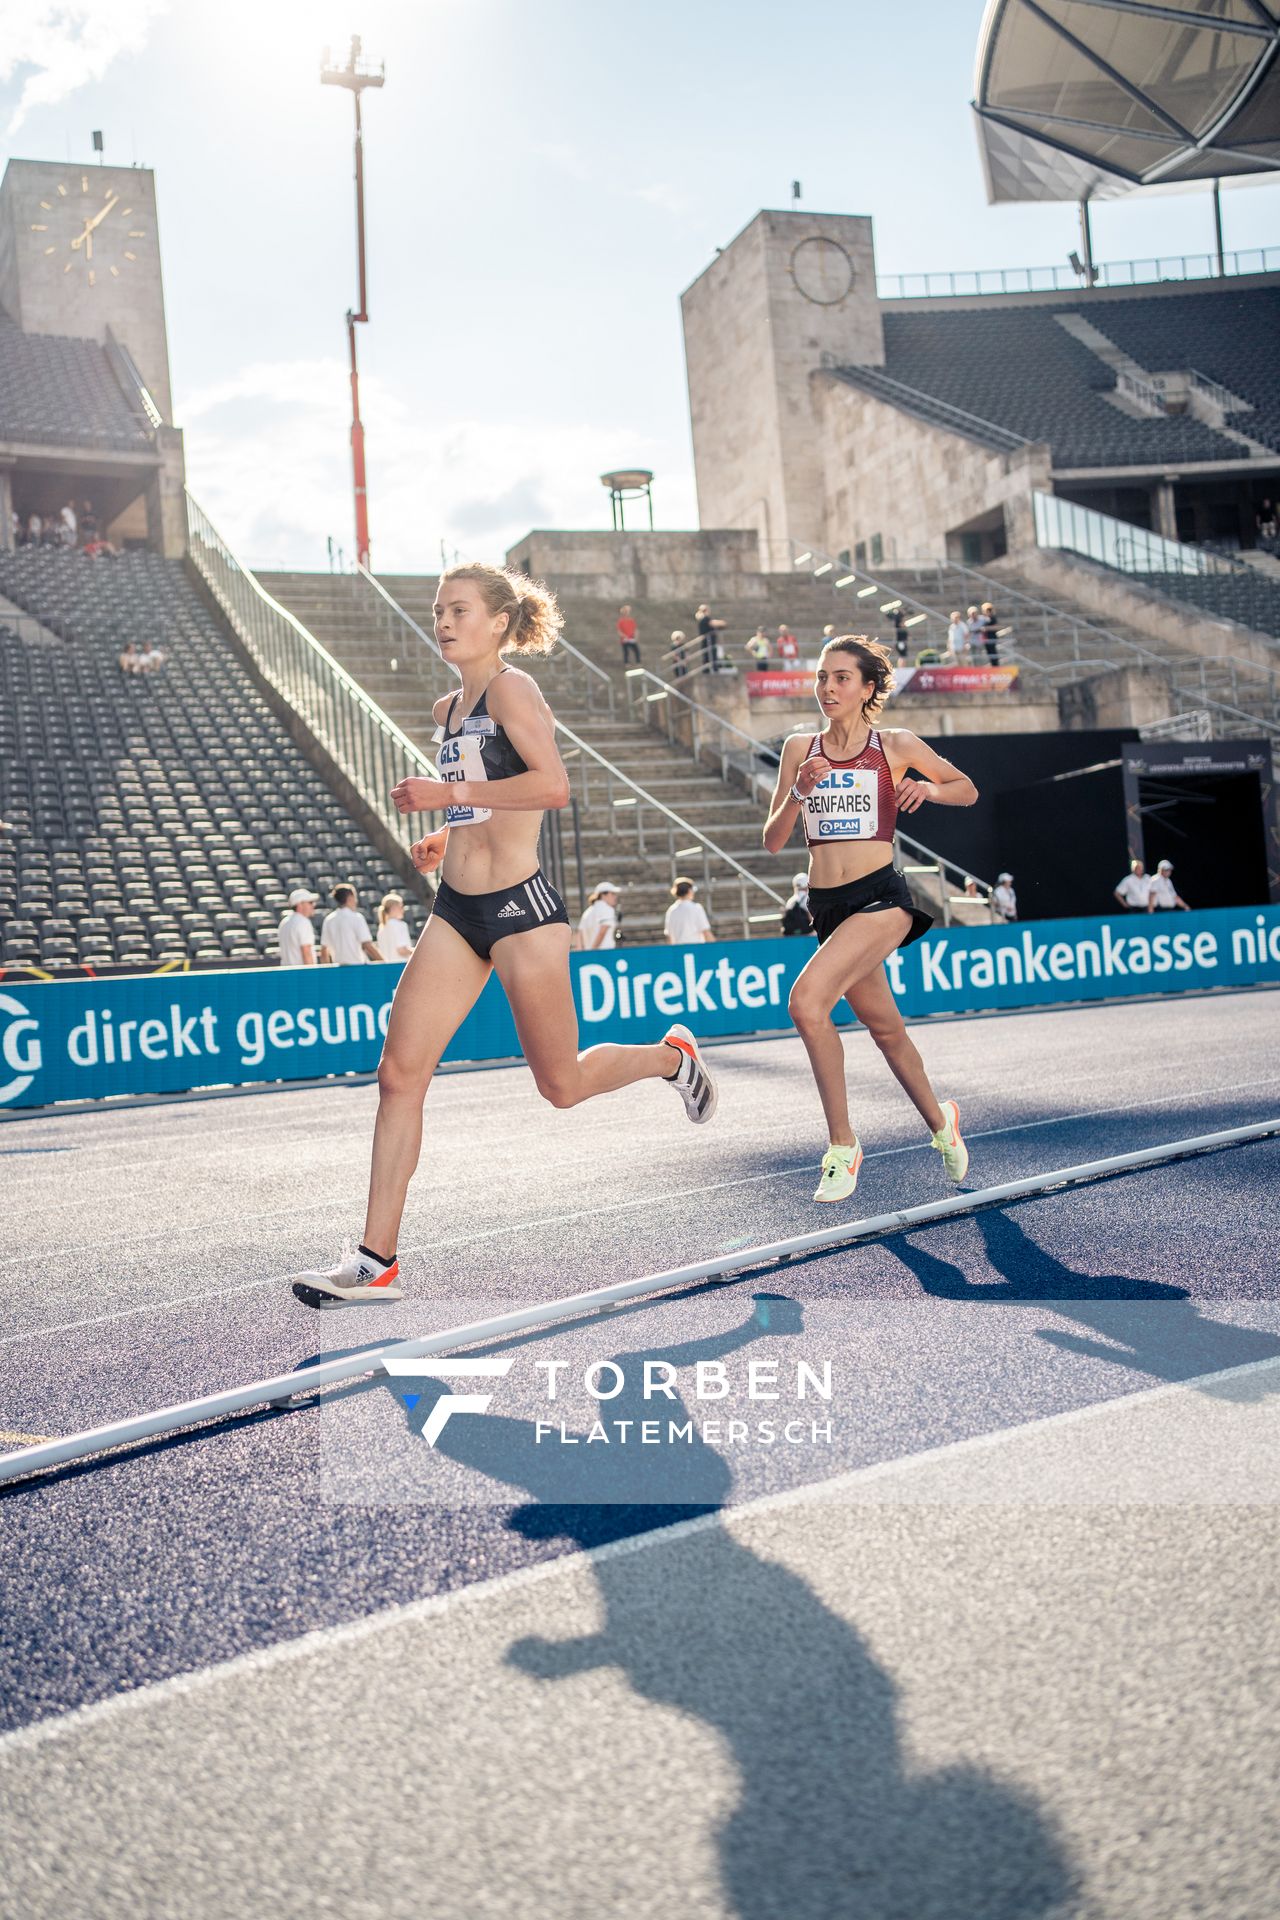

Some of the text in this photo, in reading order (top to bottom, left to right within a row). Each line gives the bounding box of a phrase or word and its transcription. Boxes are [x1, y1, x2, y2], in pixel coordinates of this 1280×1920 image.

[807, 794, 871, 814] BENFARES
[833, 821, 859, 830] PLAN
[497, 909, 526, 918] adidas
[579, 953, 786, 1022] Direkter
[920, 924, 1219, 993] Krankenkasse
[67, 1004, 220, 1066] direkt
